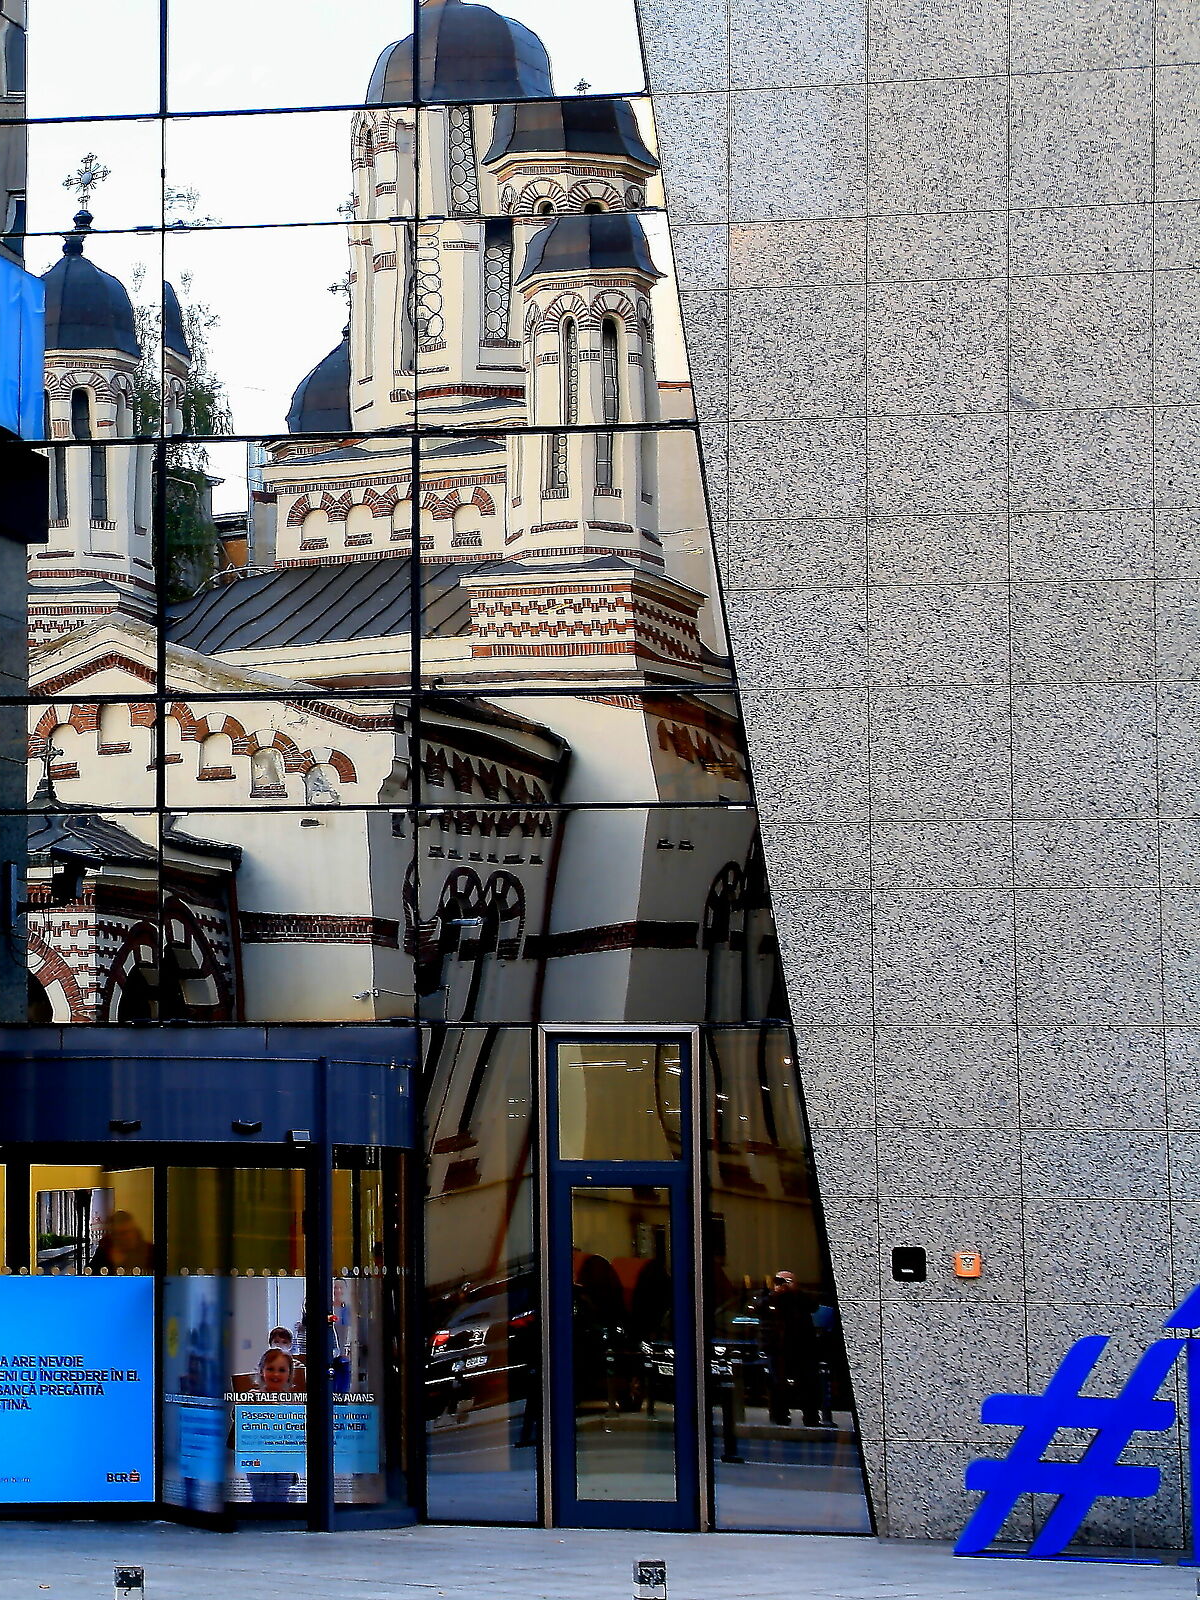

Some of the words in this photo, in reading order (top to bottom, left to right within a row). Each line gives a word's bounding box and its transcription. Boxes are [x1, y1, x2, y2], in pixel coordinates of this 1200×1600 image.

[11, 1356, 36, 1367] ARE
[39, 1356, 84, 1367] NEVOIE
[20, 1371, 36, 1381] CU
[40, 1368, 108, 1381] ÎNCREDERE
[111, 1368, 125, 1381] ÎN
[39, 1382, 104, 1395] PREGĂTITĂ
[256, 1392, 278, 1402] TALE
[279, 1392, 292, 1402] CU
[343, 1393, 374, 1402] AVANS
[285, 1422, 306, 1431] Cred
[107, 1473, 128, 1482] BCR
